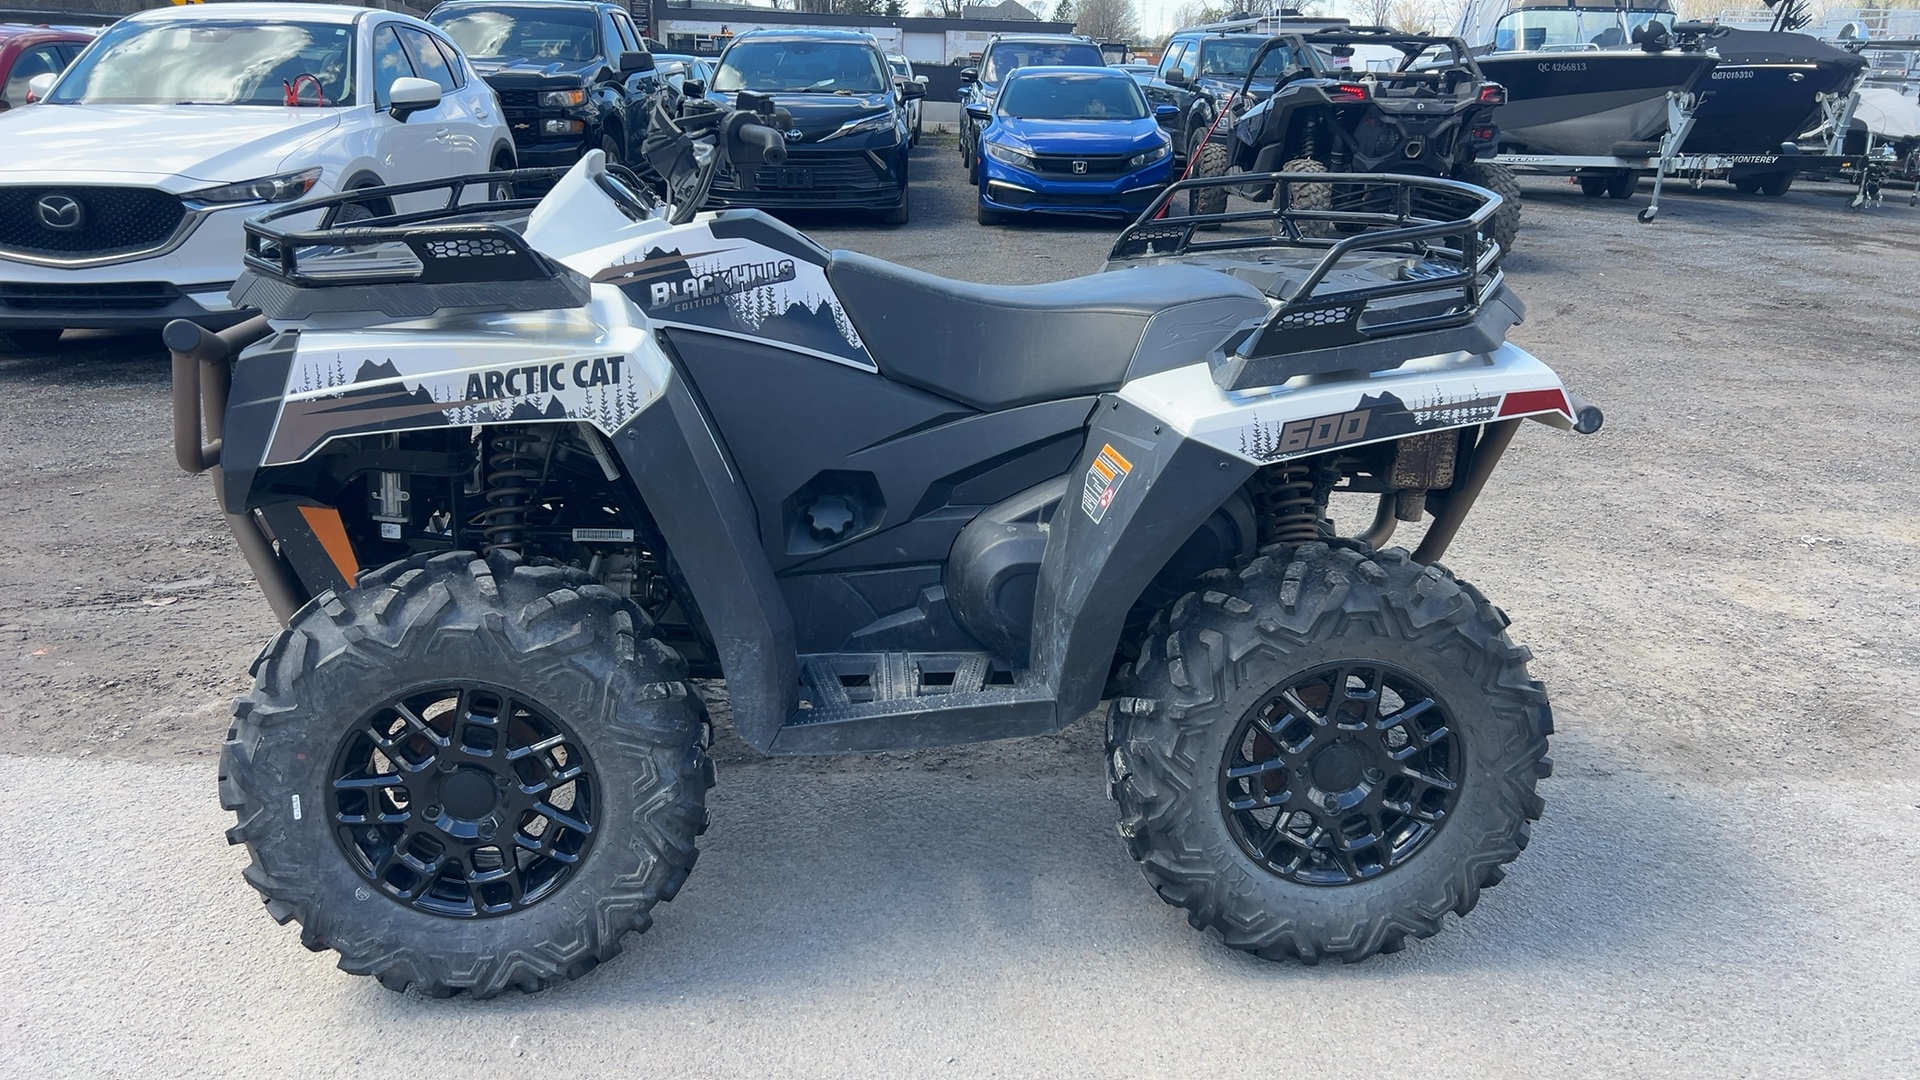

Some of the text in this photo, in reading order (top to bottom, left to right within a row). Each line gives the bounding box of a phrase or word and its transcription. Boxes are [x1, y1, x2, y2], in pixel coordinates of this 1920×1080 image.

[1537, 62, 1587, 73] QC 4266813
[1731, 155, 1779, 164] MONTEREY
[674, 296, 720, 313] EDITION
[465, 355, 625, 401] ARCTIC CAT
[1272, 409, 1371, 455] 600
